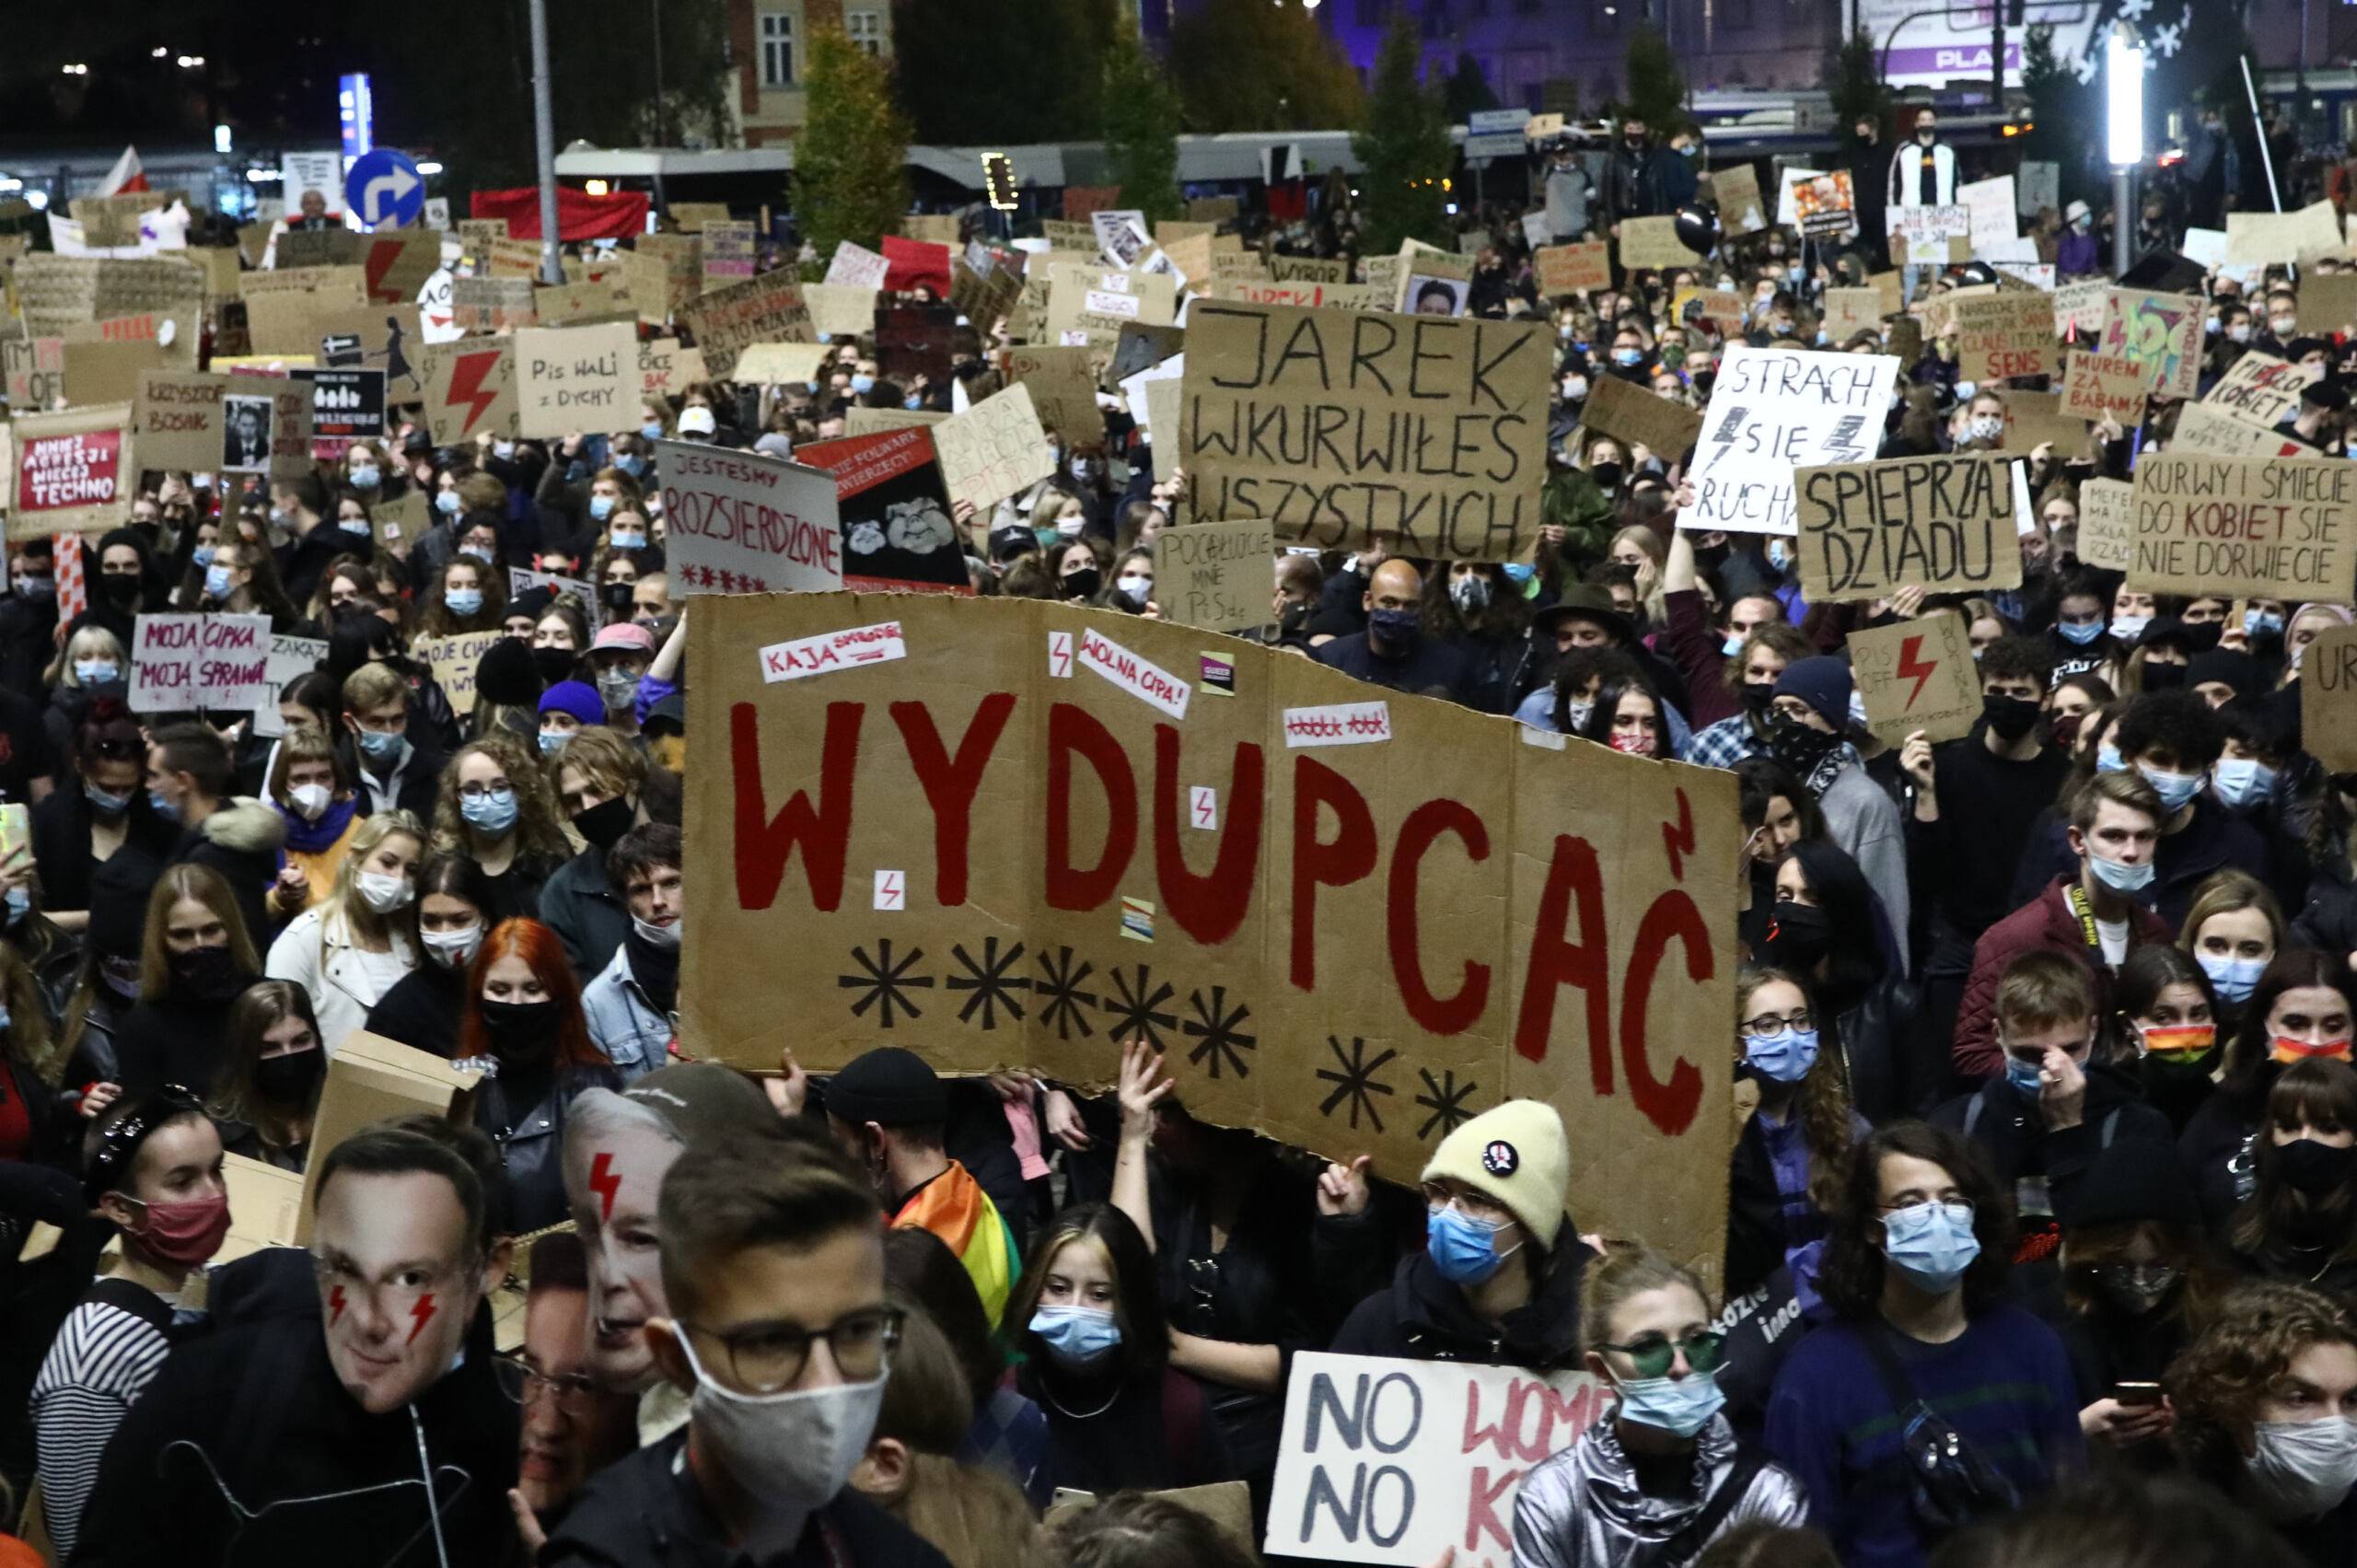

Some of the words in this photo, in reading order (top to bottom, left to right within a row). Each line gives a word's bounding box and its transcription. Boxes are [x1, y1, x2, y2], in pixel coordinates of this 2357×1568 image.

[1200, 308, 1536, 411] JAREK
[1733, 356, 1876, 407] STRACH
[1987, 350, 2041, 377] SENS
[2074, 373, 2103, 390] ZA
[2076, 354, 2140, 378] MUREM
[1192, 394, 1527, 482] WKURWIŁEŚ
[30, 476, 115, 505] TECHNO
[1805, 459, 2014, 532] SPIEPRZAJ
[2141, 460, 2232, 496] KURWY
[2259, 460, 2352, 504] ŚMIECIE
[664, 486, 840, 575] ROZSIERDZONE
[1190, 475, 1521, 559] WSZYSTKICH
[2139, 502, 2174, 535] DO
[2184, 502, 2293, 542] KOBIET
[1822, 521, 1992, 592] DZIADU
[2137, 540, 2186, 576] NIE
[2194, 541, 2335, 585] DORWIECIE
[145, 622, 196, 649] MOJA
[418, 642, 456, 663] MOJE
[767, 645, 840, 673] KAJA
[1080, 633, 1137, 684] WOLNA
[1861, 671, 1893, 694] OFF
[1303, 1371, 1422, 1455] NO
[1298, 1460, 1415, 1549] NO
